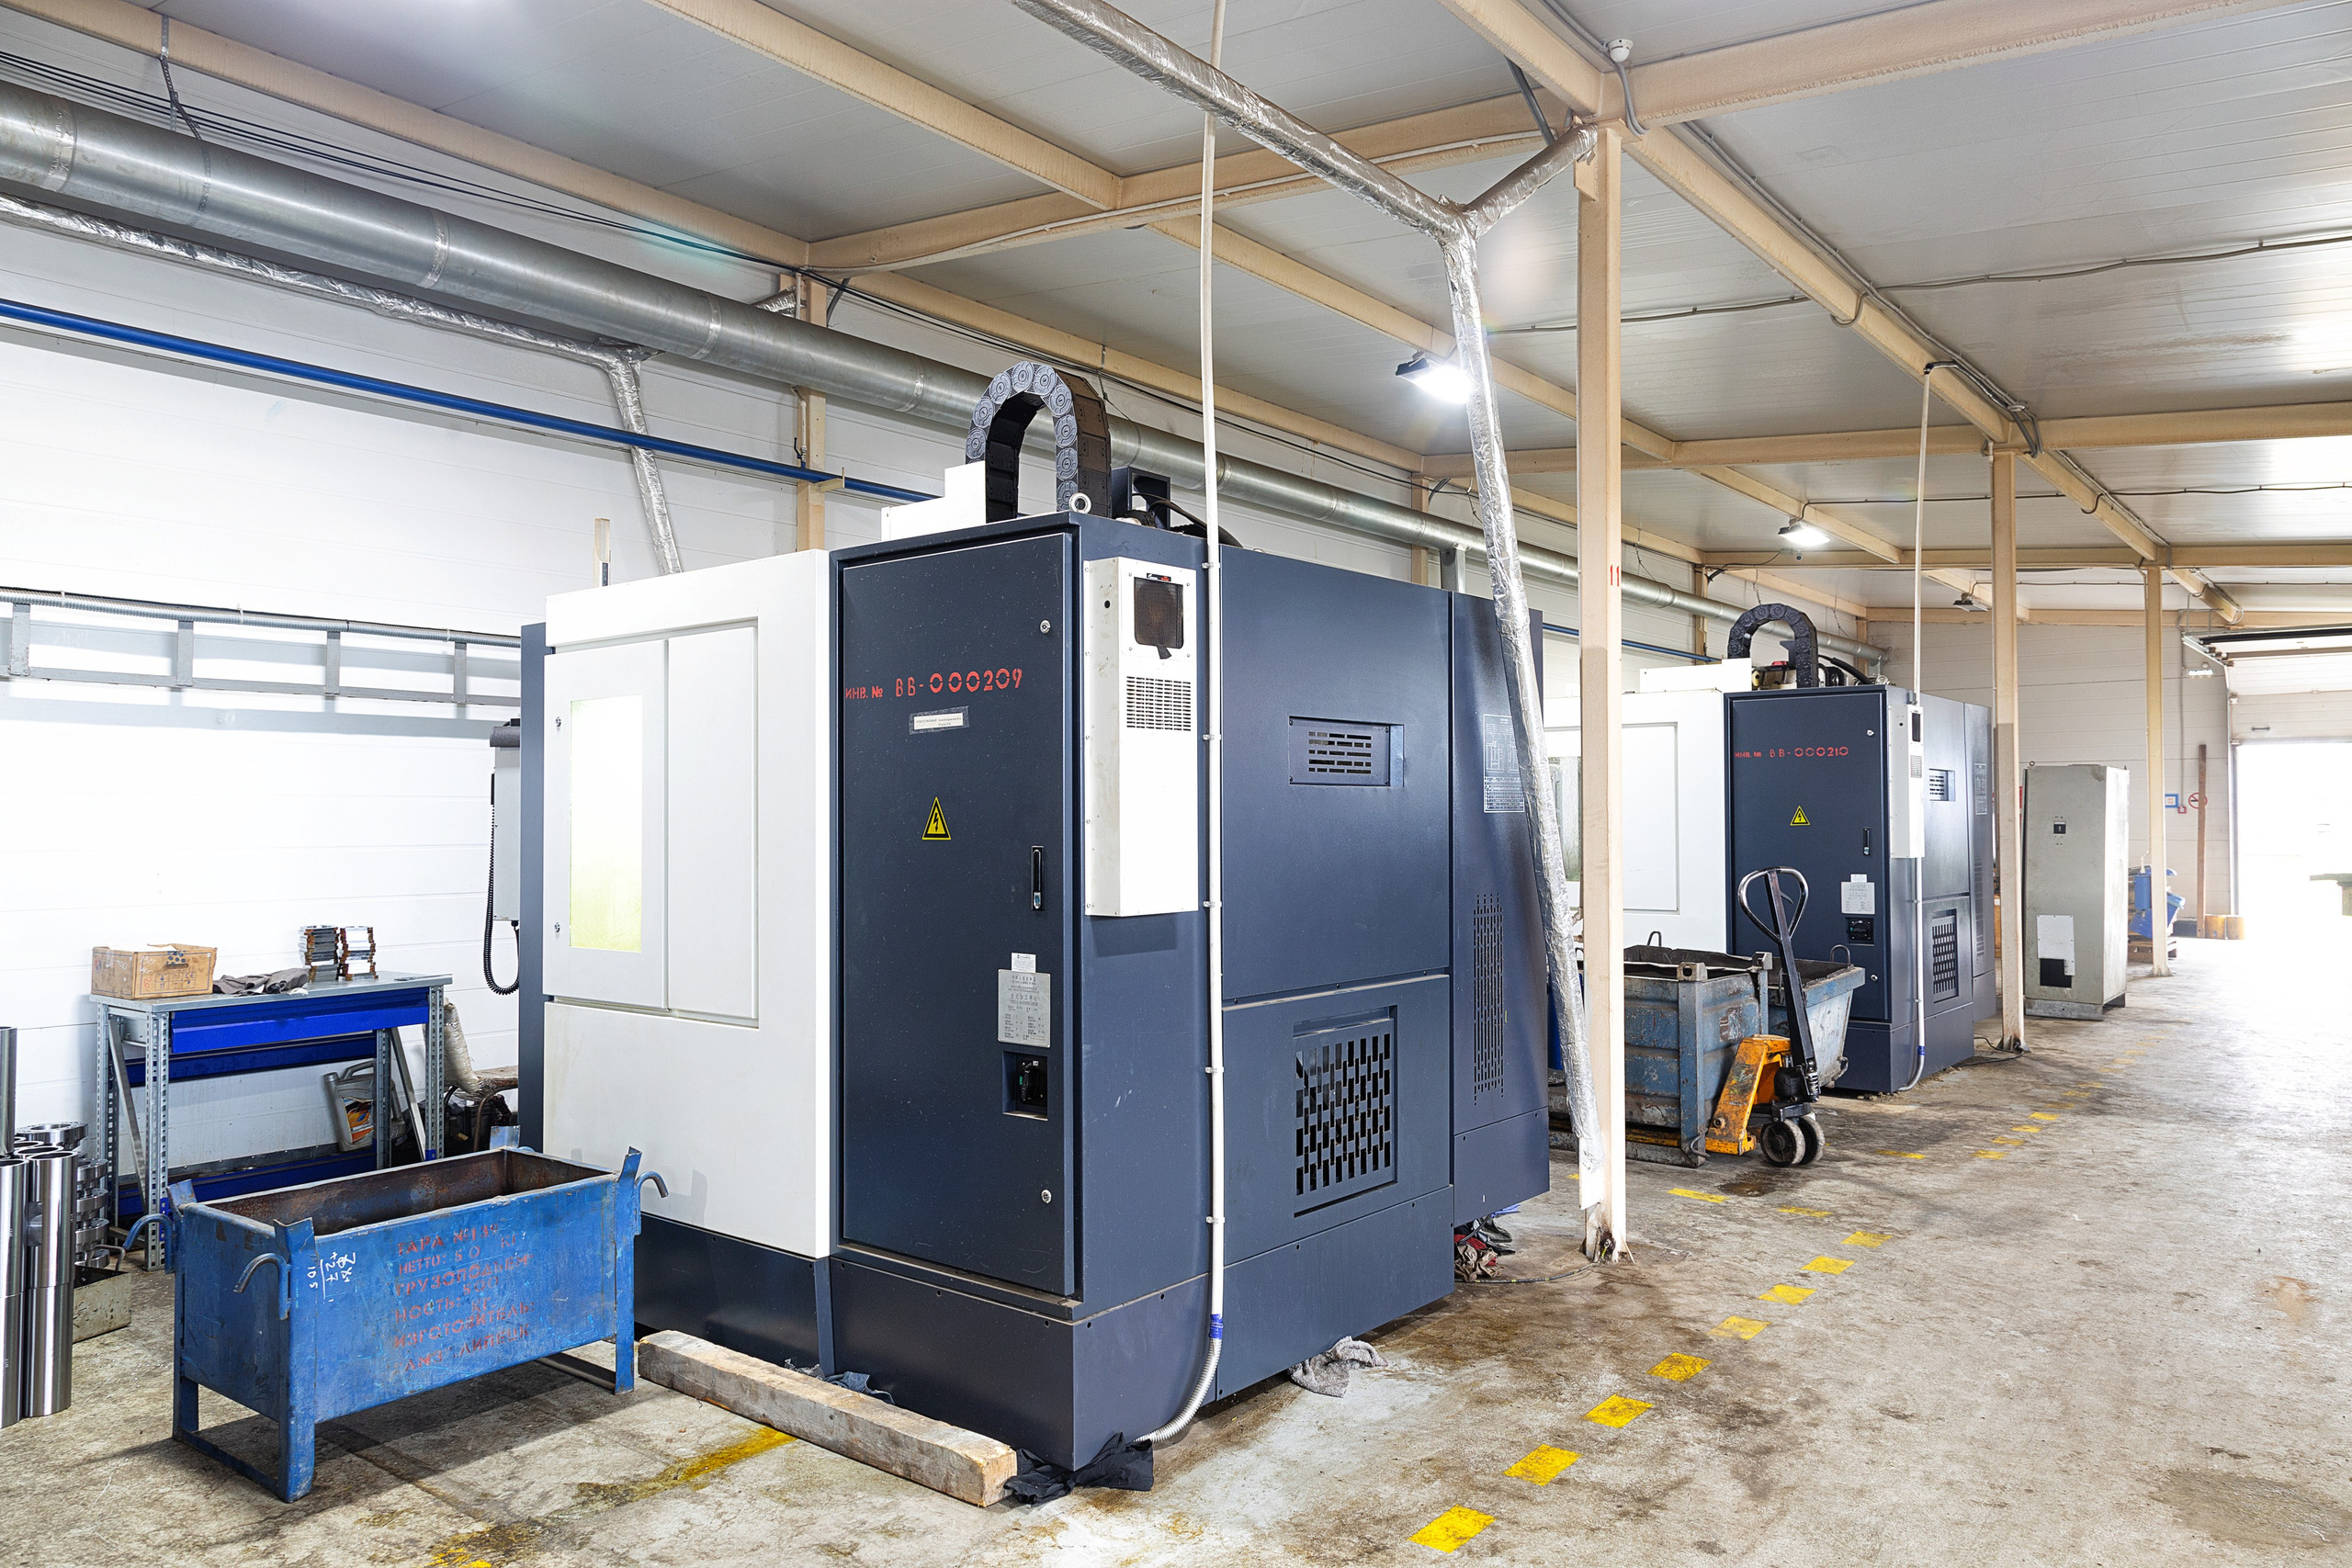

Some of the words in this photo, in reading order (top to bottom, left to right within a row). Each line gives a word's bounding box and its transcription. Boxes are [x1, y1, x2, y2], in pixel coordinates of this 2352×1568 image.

[845, 686, 868, 699] ИНВ.
[397, 1235, 445, 1257] ТАРА
[399, 1254, 447, 1275] НЕТТО:
[395, 1297, 460, 1324] НОСТЬ:
[463, 1276, 499, 1295] 500
